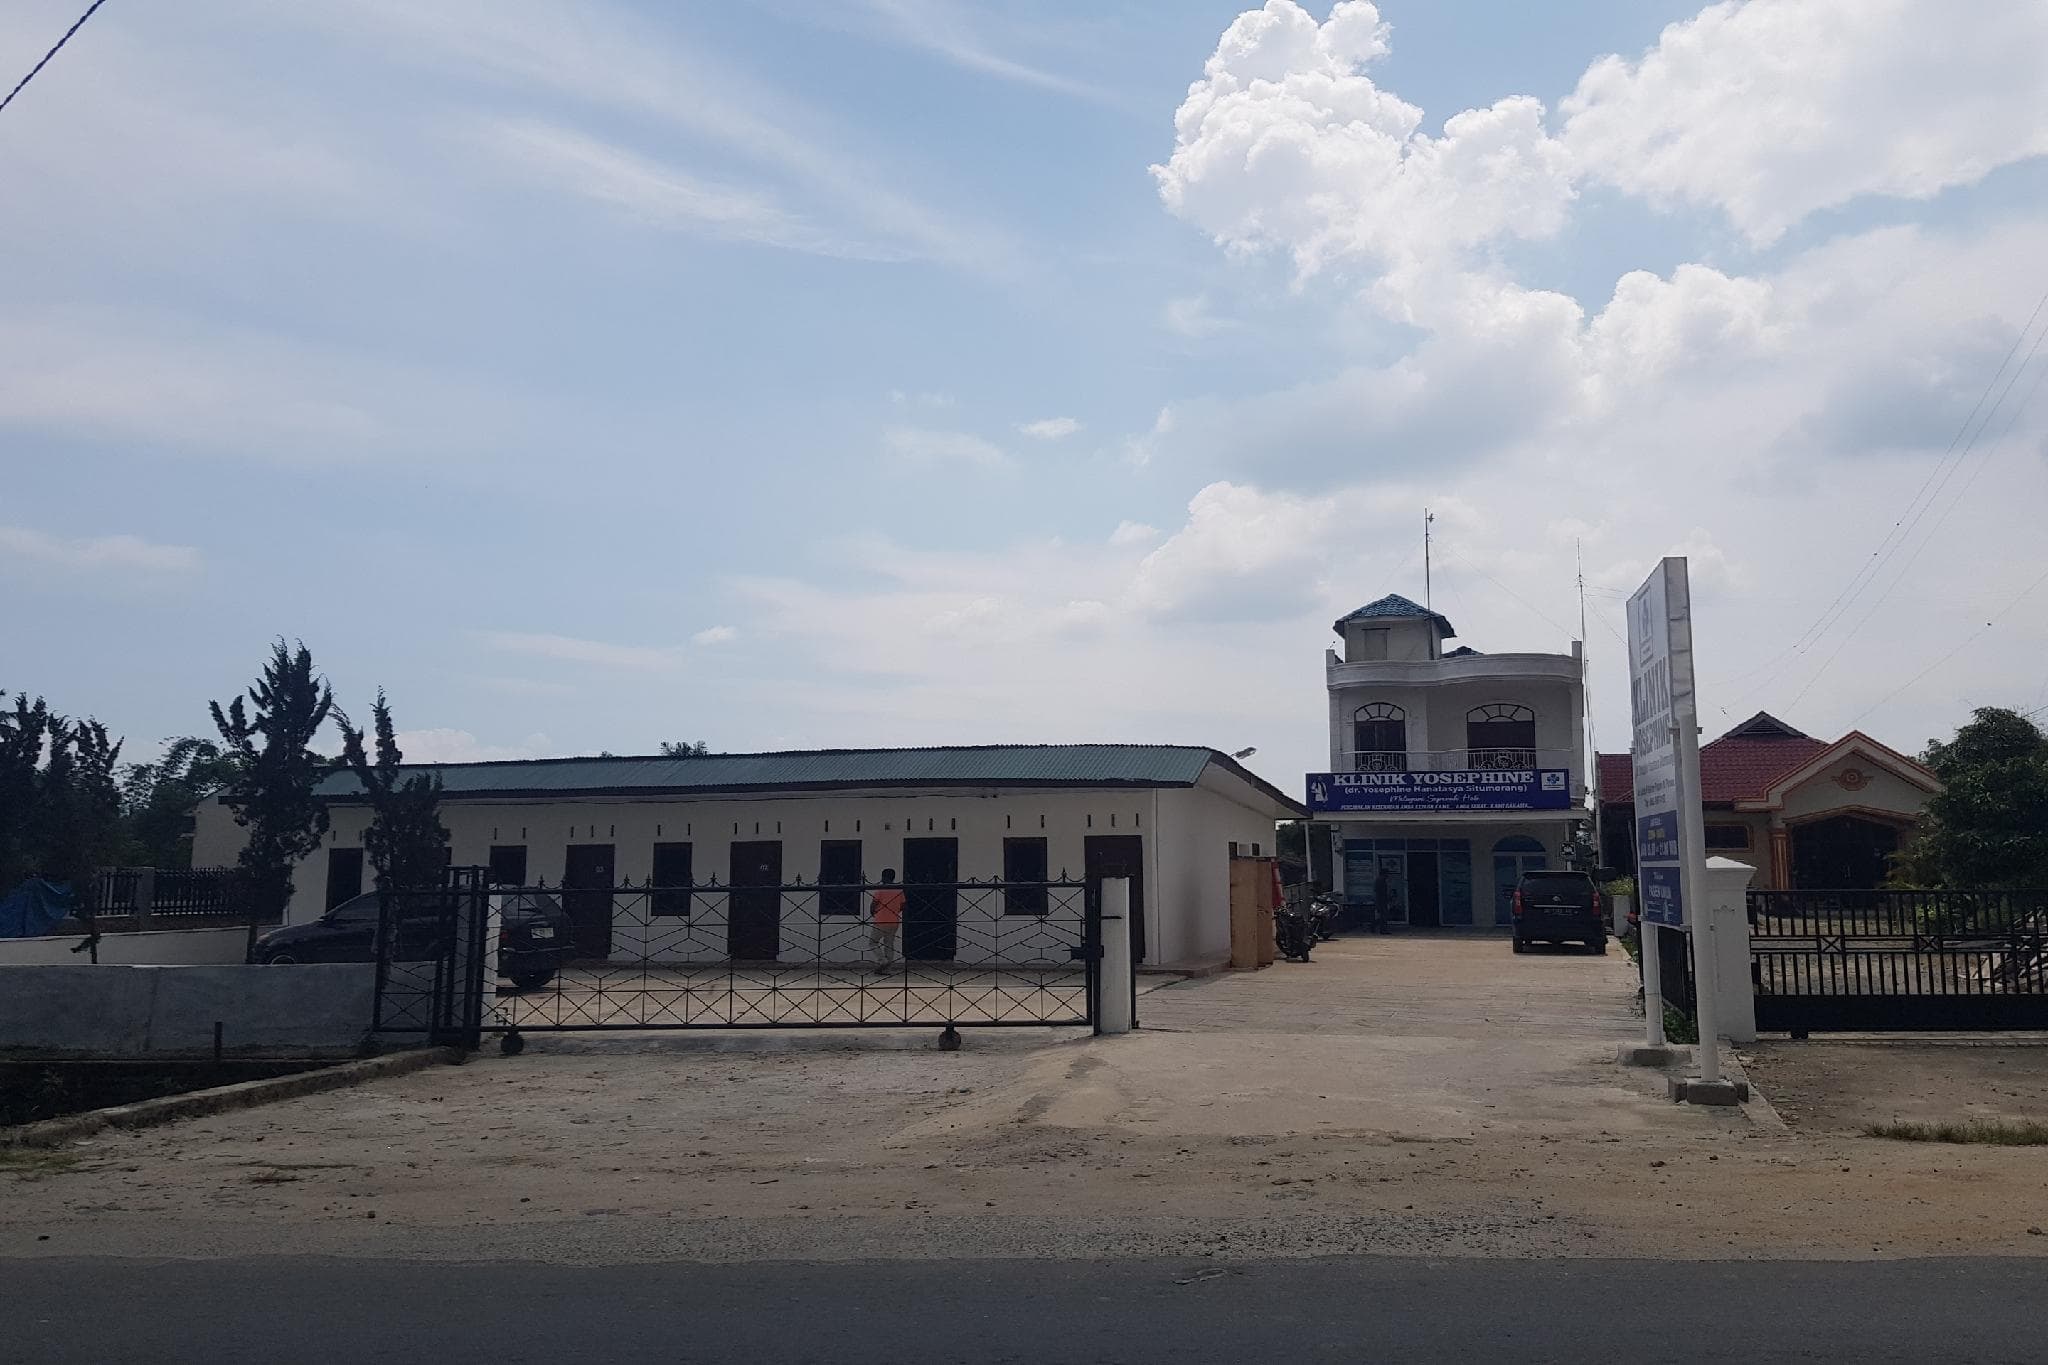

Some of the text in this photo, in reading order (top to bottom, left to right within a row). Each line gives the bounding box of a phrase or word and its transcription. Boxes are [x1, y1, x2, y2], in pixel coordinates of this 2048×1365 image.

[1333, 771, 1534, 786] KLINIK YOSEPHINE
[1363, 786, 1411, 794] Yosephine
[1465, 784, 1528, 792] Situmorang)
